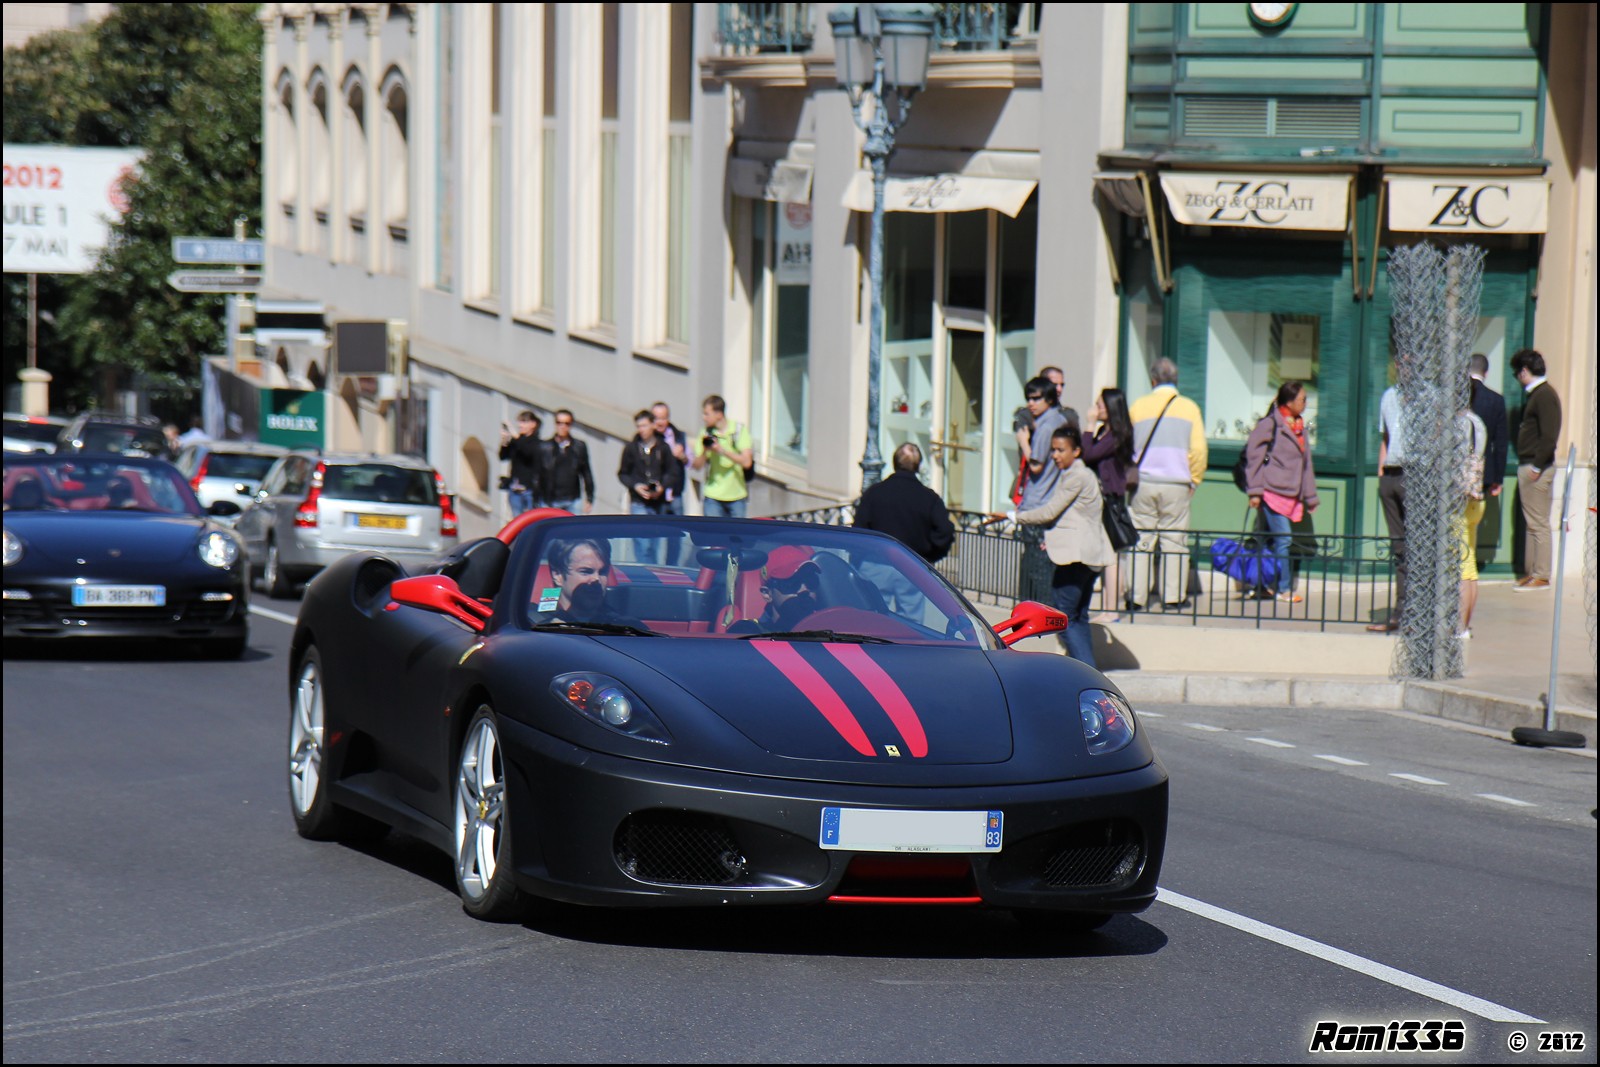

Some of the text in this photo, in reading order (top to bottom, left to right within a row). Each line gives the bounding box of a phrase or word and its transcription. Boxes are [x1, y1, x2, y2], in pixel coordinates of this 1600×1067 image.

[3, 165, 62, 188] 2012
[1185, 193, 1227, 208] ZEGG
[1244, 197, 1314, 211] CERLATI
[266, 414, 317, 431] ROLEX
[827, 830, 833, 839] F
[986, 831, 1000, 845] 83
